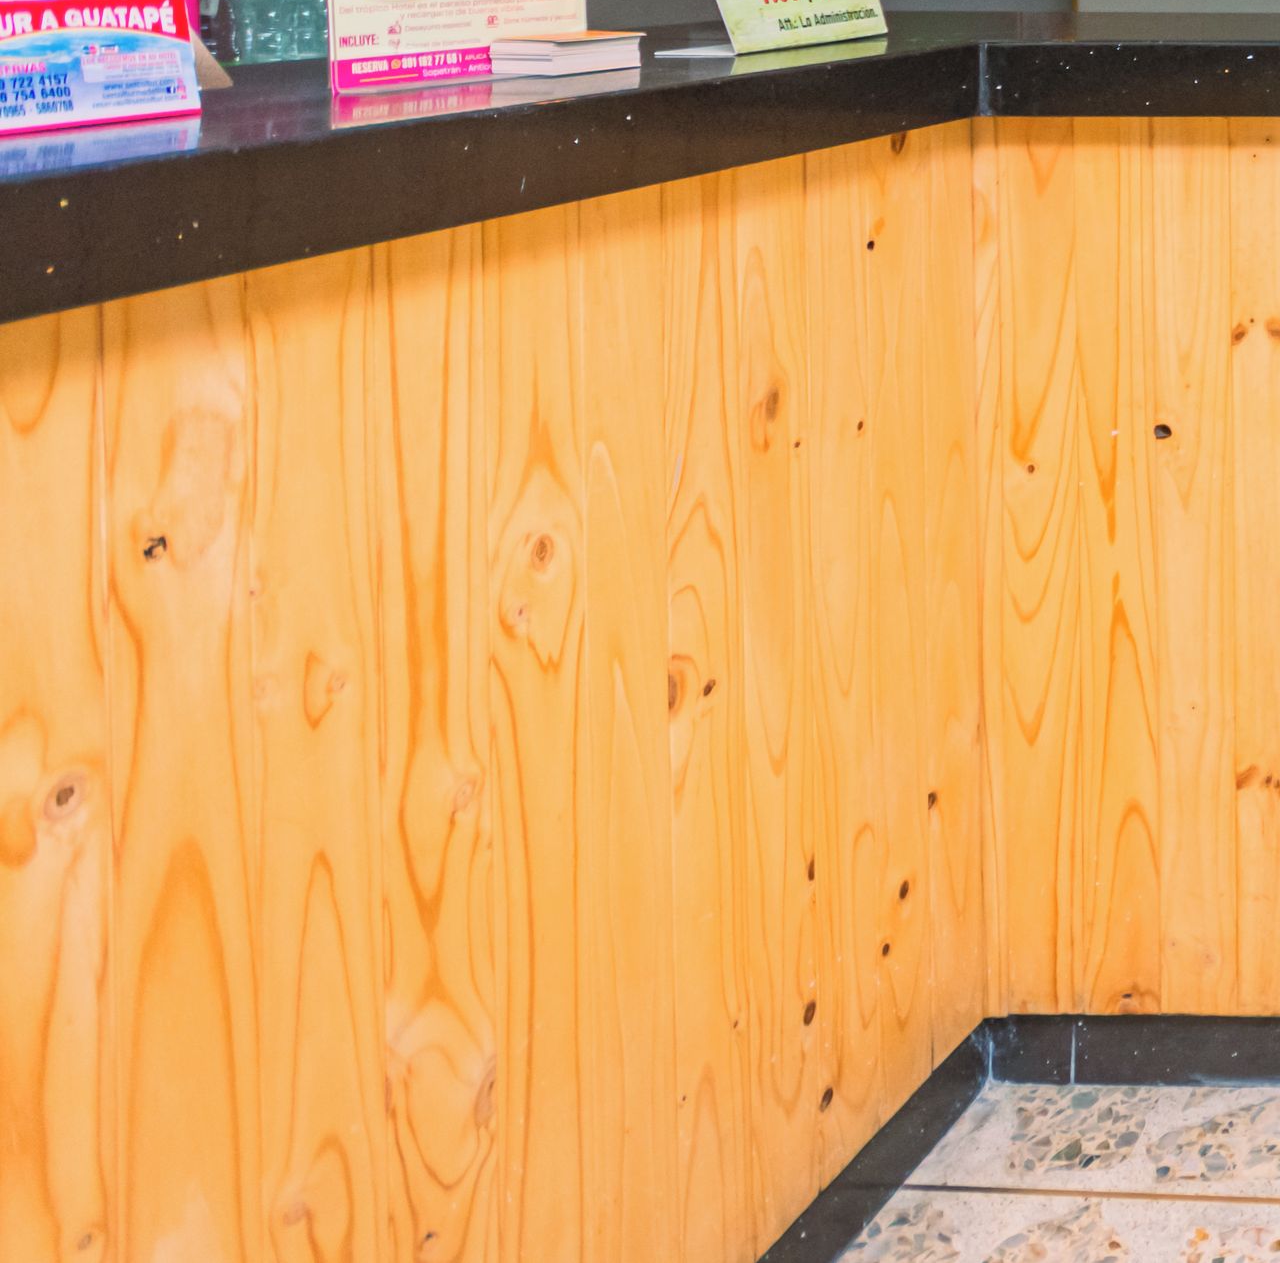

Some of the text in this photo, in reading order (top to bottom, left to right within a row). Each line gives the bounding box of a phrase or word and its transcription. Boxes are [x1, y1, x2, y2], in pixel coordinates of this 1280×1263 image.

[41, 9, 59, 31] A
[64, 0, 177, 34] GUATAPÉ
[800, 15, 813, 28] La
[339, 33, 380, 48] INCLUYE:
[351, 58, 389, 75] RESERVA
